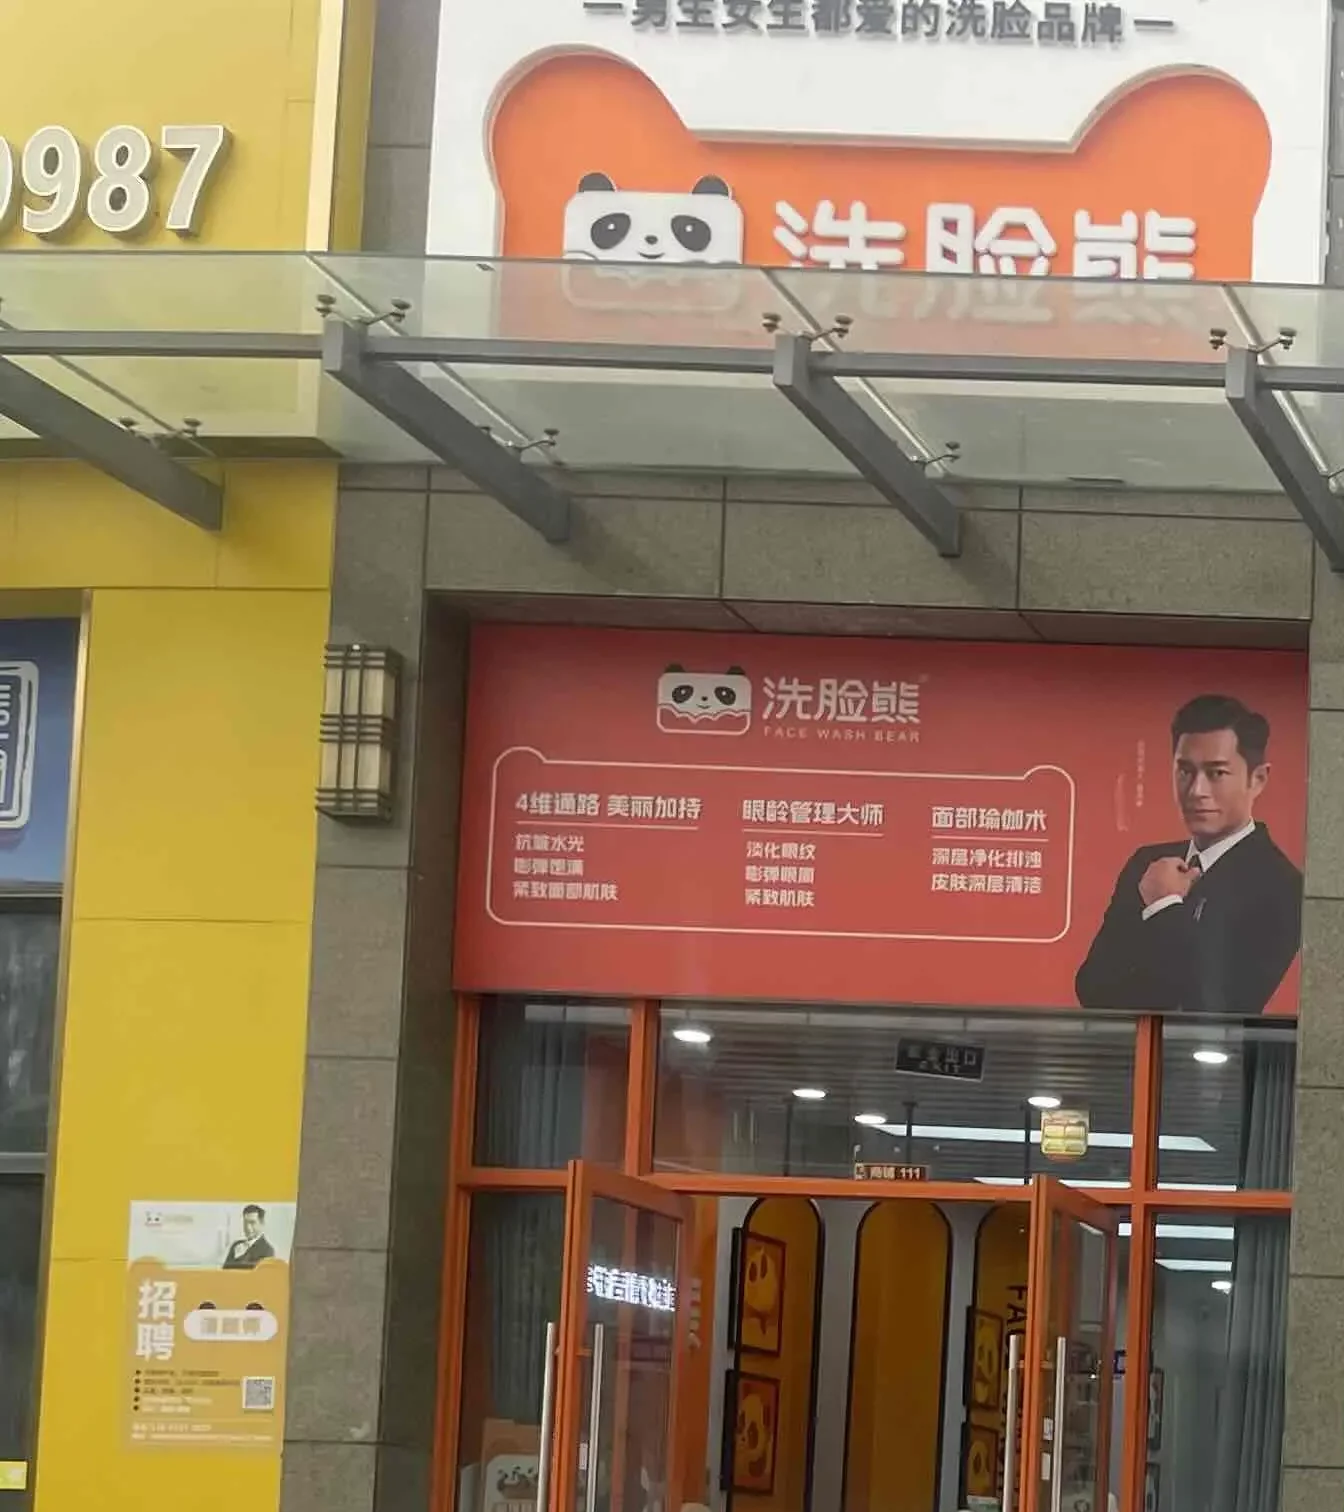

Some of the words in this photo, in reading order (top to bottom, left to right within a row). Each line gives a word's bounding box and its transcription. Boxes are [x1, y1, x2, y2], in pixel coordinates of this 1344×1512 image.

[0, 124, 226, 234] 987
[762, 676, 921, 724] 洗脸熊
[763, 725, 808, 739] FACE
[817, 728, 866, 741] WASH
[873, 730, 920, 743] BEAR
[607, 794, 702, 820] 美丽加持
[742, 799, 884, 826] 眼龄管理大师
[931, 806, 1048, 831] 面部瑜伽术
[136, 1279, 177, 1361] 招聘
